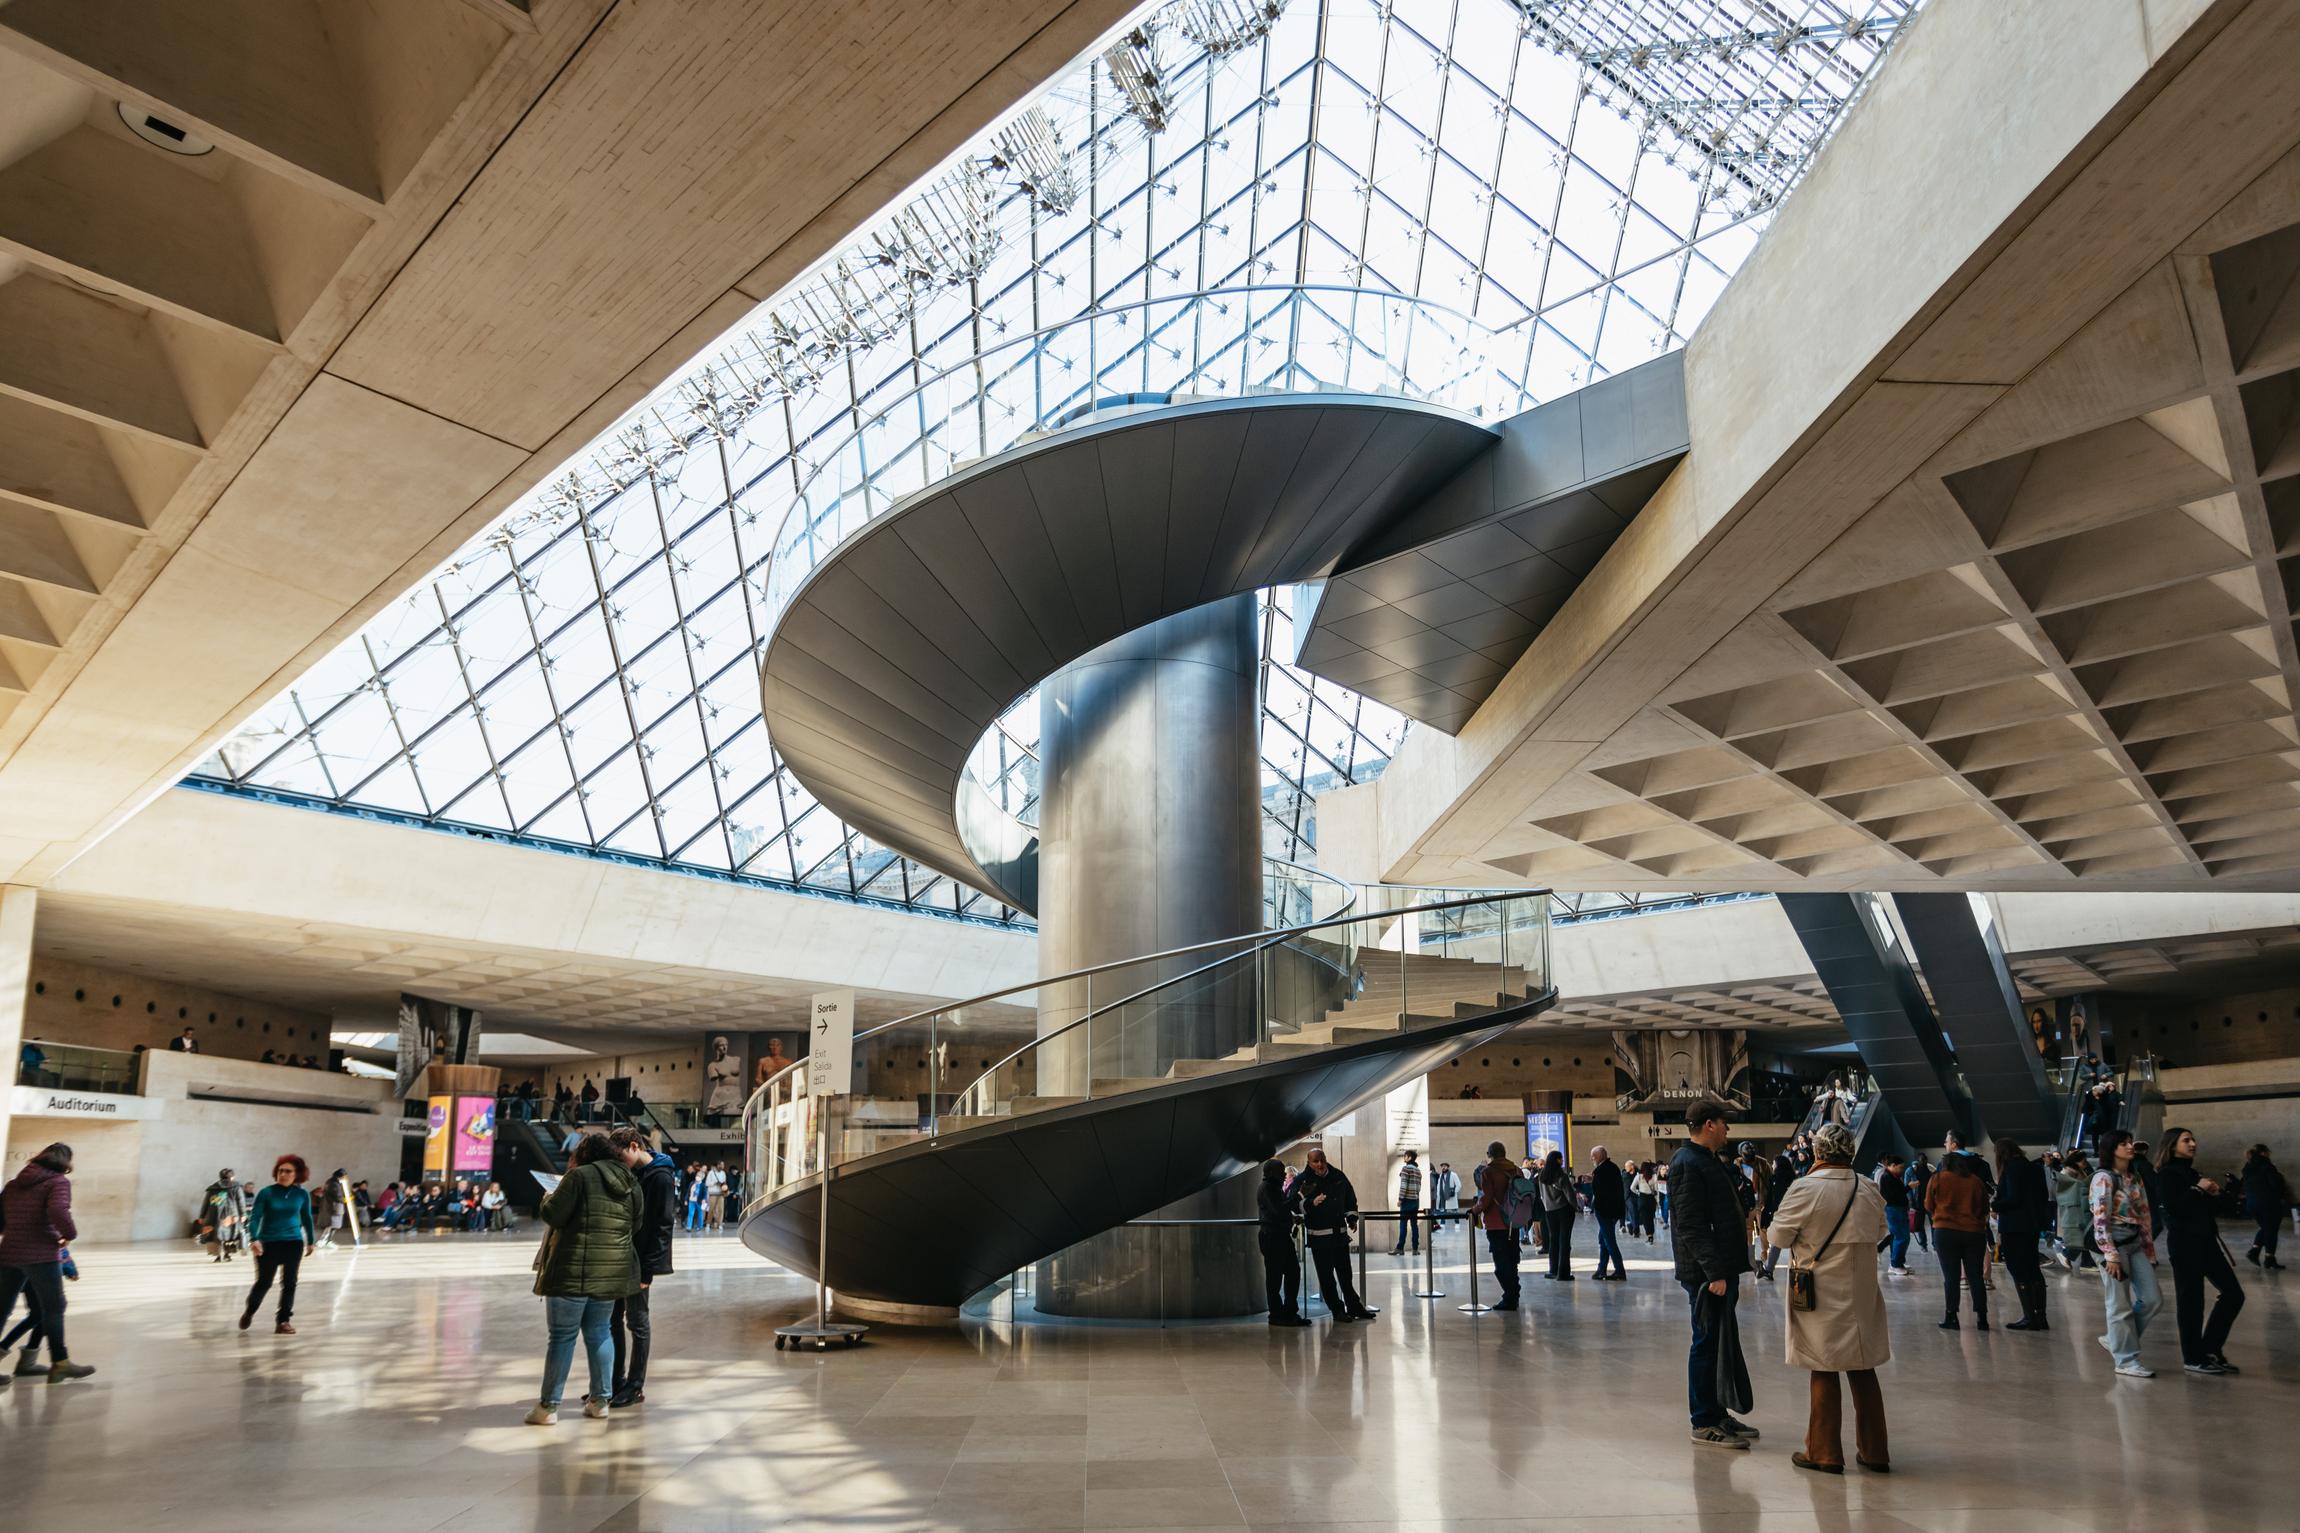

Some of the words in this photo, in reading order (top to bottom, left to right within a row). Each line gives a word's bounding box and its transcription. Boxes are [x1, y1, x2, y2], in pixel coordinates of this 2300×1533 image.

[817, 1003, 838, 1013] Sortie
[815, 1049, 827, 1058] Exit
[814, 1062, 832, 1071] Salida
[813, 1075, 826, 1084] 出口
[1663, 1090, 1703, 1098] DENON
[48, 1096, 116, 1112] Auditorium
